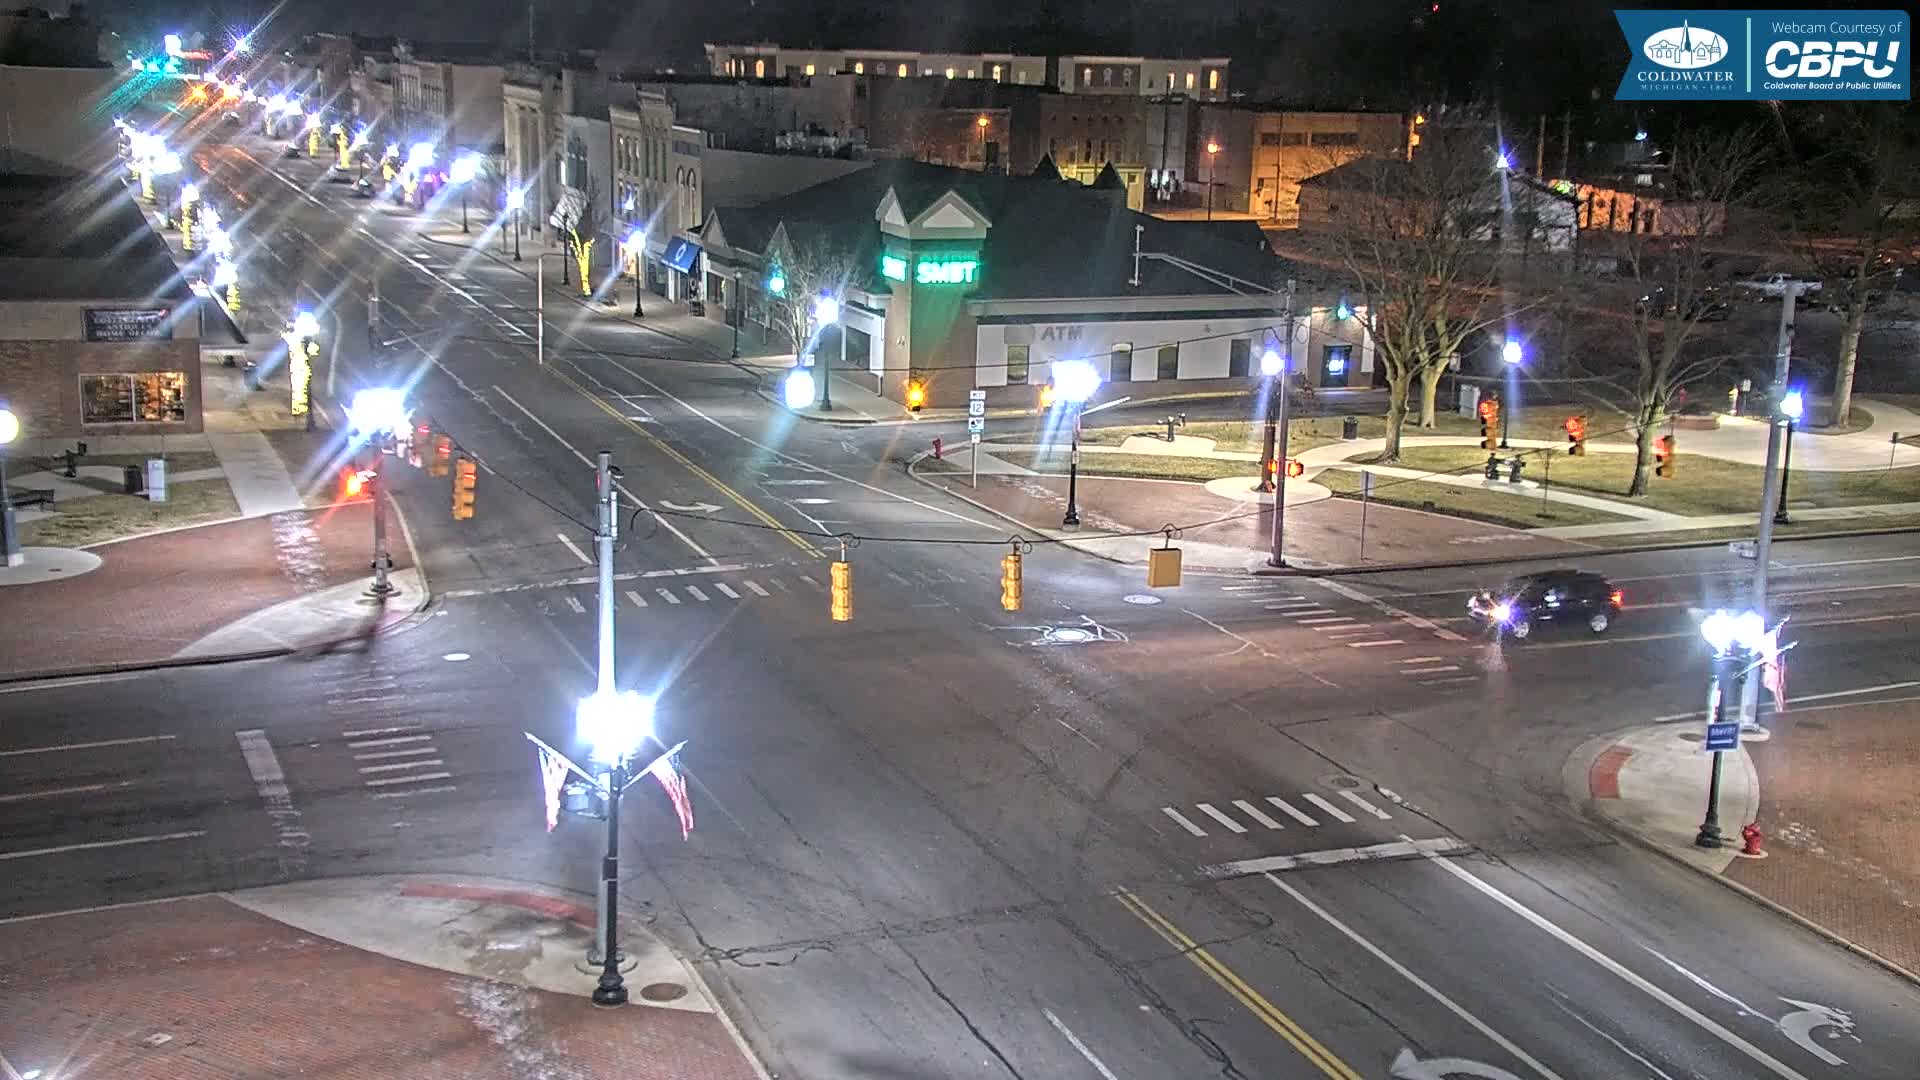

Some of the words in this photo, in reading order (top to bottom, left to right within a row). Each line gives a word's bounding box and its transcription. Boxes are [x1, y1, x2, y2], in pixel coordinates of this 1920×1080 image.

[917, 261, 978, 284] SMBT
[1041, 325, 1083, 341] ATM
[972, 403, 982, 413] 12
